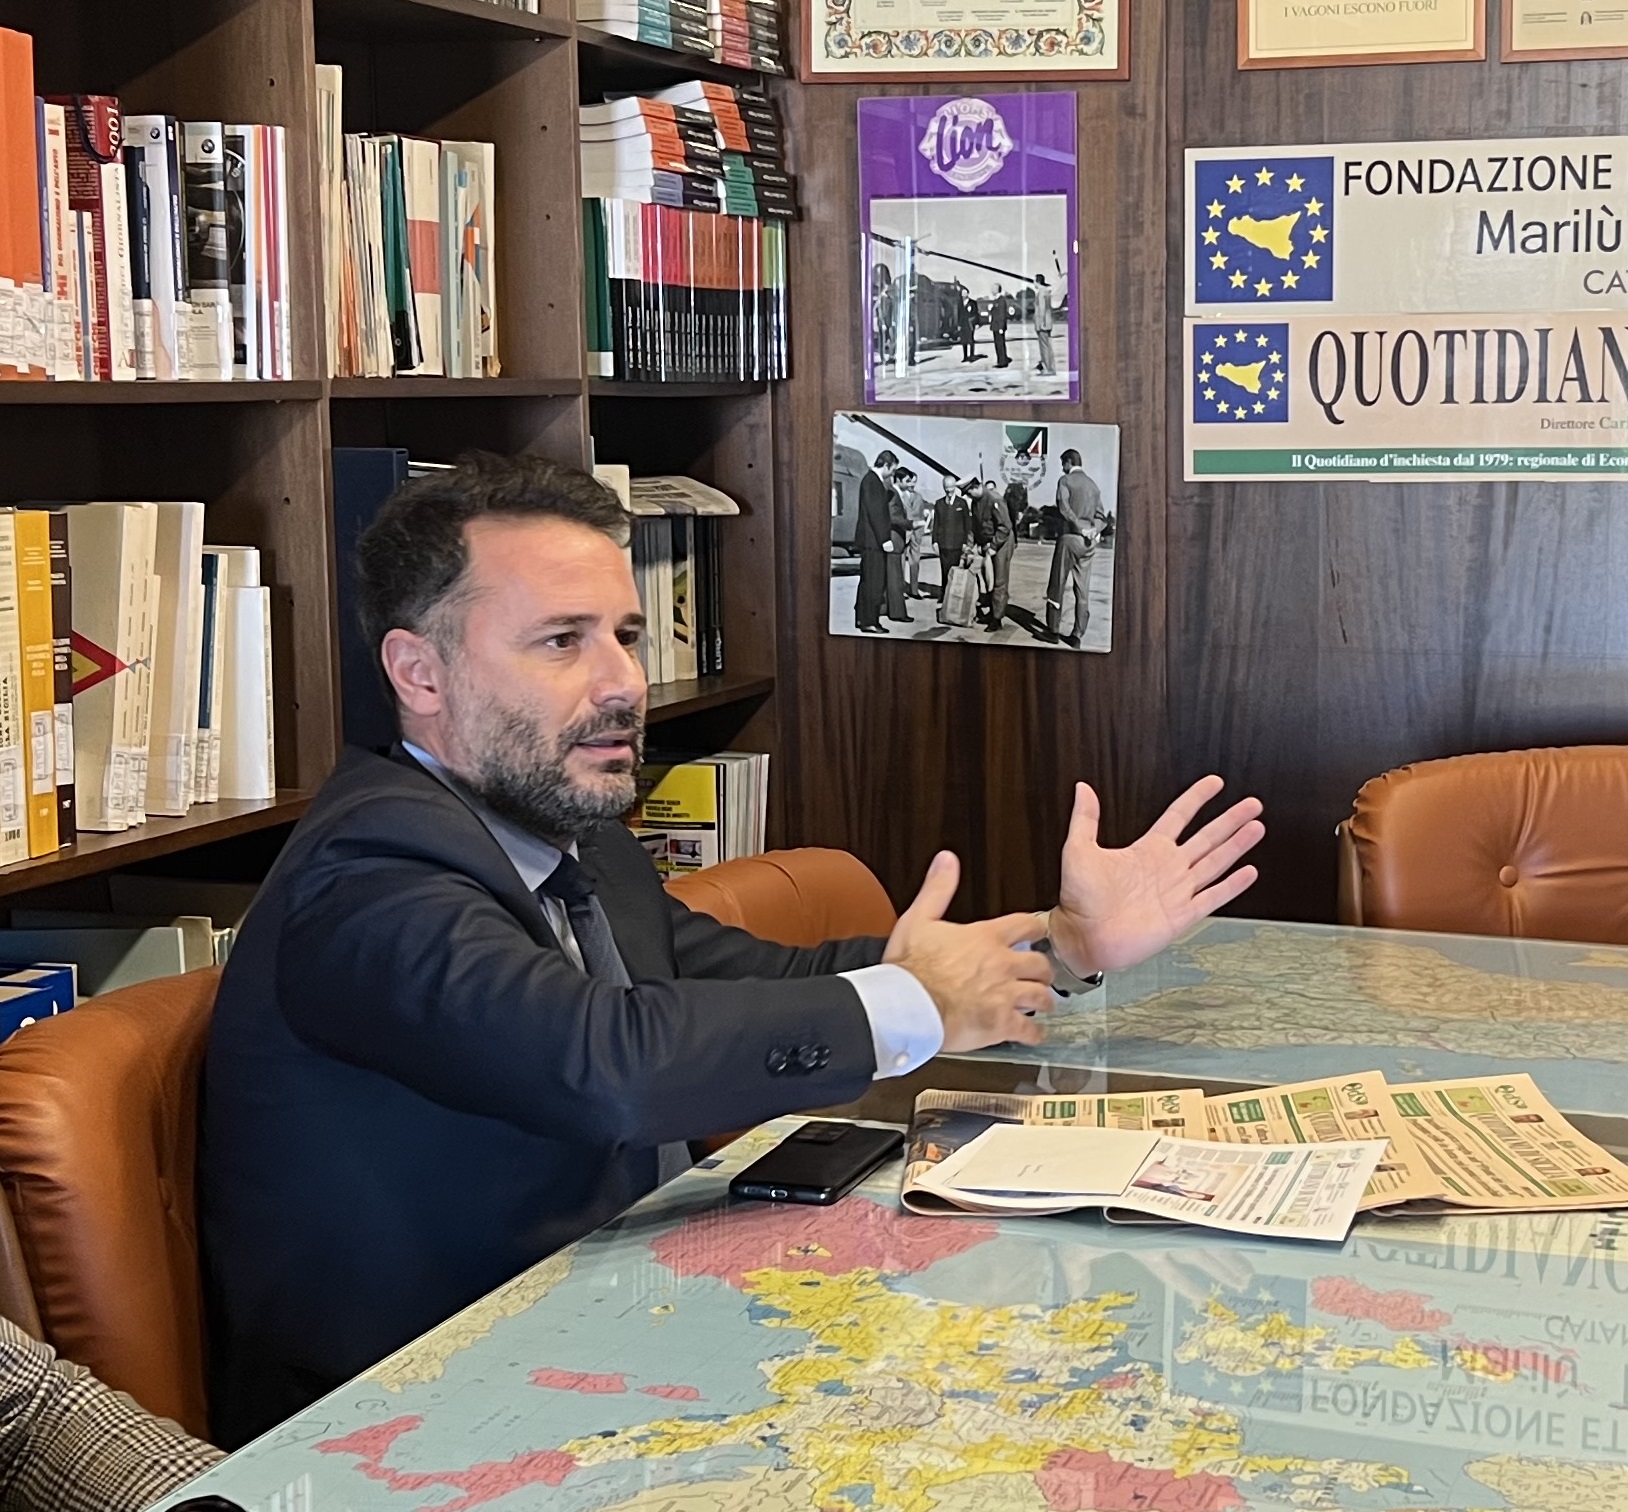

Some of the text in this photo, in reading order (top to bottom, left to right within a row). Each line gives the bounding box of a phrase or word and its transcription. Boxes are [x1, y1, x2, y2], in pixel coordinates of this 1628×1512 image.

[1291, 3, 1340, 18] VAGONI
[1343, 1, 1395, 15] ESCONO
[1398, 0, 1438, 13] FUORI
[936, 114, 1002, 172] Lion
[1343, 154, 1613, 196] FONDAZIONE
[1476, 204, 1622, 255] Marilù
[1583, 269, 1628, 294] CA
[1539, 416, 1628, 430] Direttore Car
[1291, 455, 1301, 467] Il
[1304, 454, 1378, 469] Quotidiano
[1380, 453, 1451, 467] d'inchiesta
[1454, 453, 1475, 467] dal
[1478, 453, 1514, 467] 1979:
[1517, 453, 1579, 468] regionale
[1580, 453, 1596, 467] di
